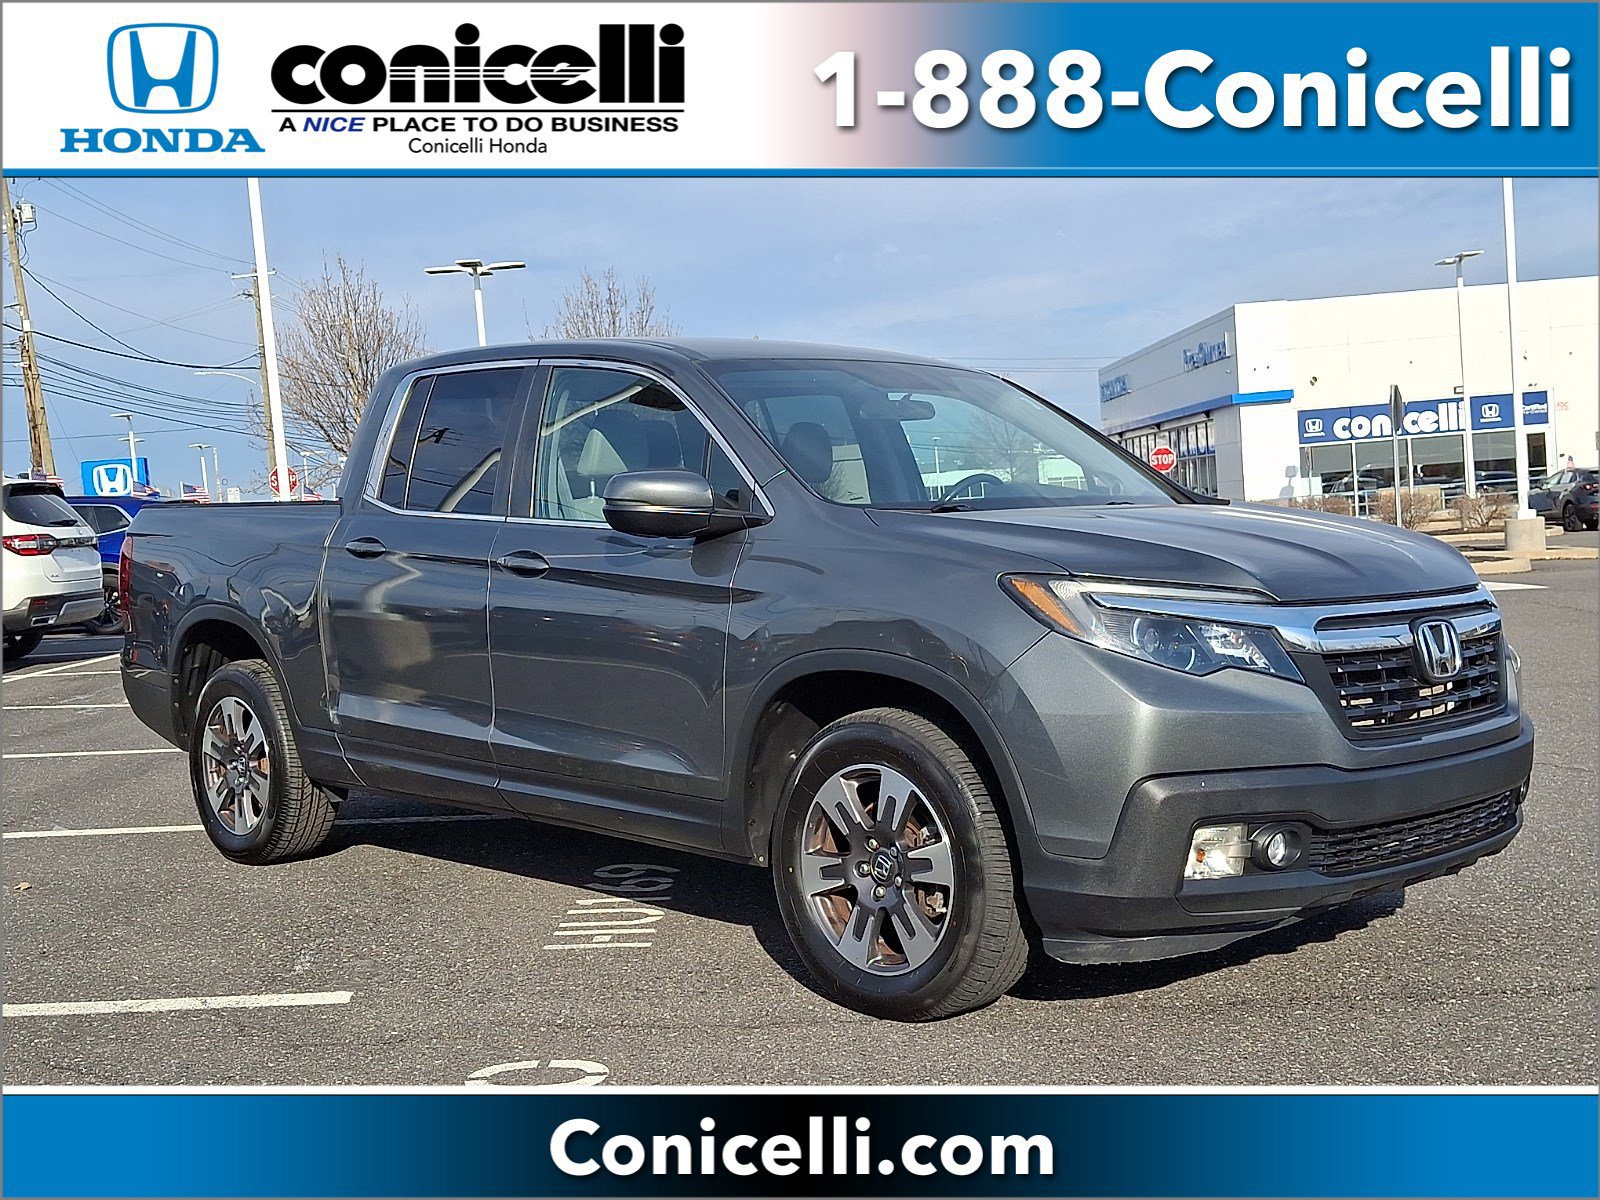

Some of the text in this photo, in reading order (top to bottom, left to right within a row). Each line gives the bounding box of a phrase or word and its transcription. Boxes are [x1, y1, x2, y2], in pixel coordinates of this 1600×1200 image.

[1333, 401, 1466, 439] concelli
[1151, 454, 1174, 466] STOP
[271, 475, 296, 487] SP
